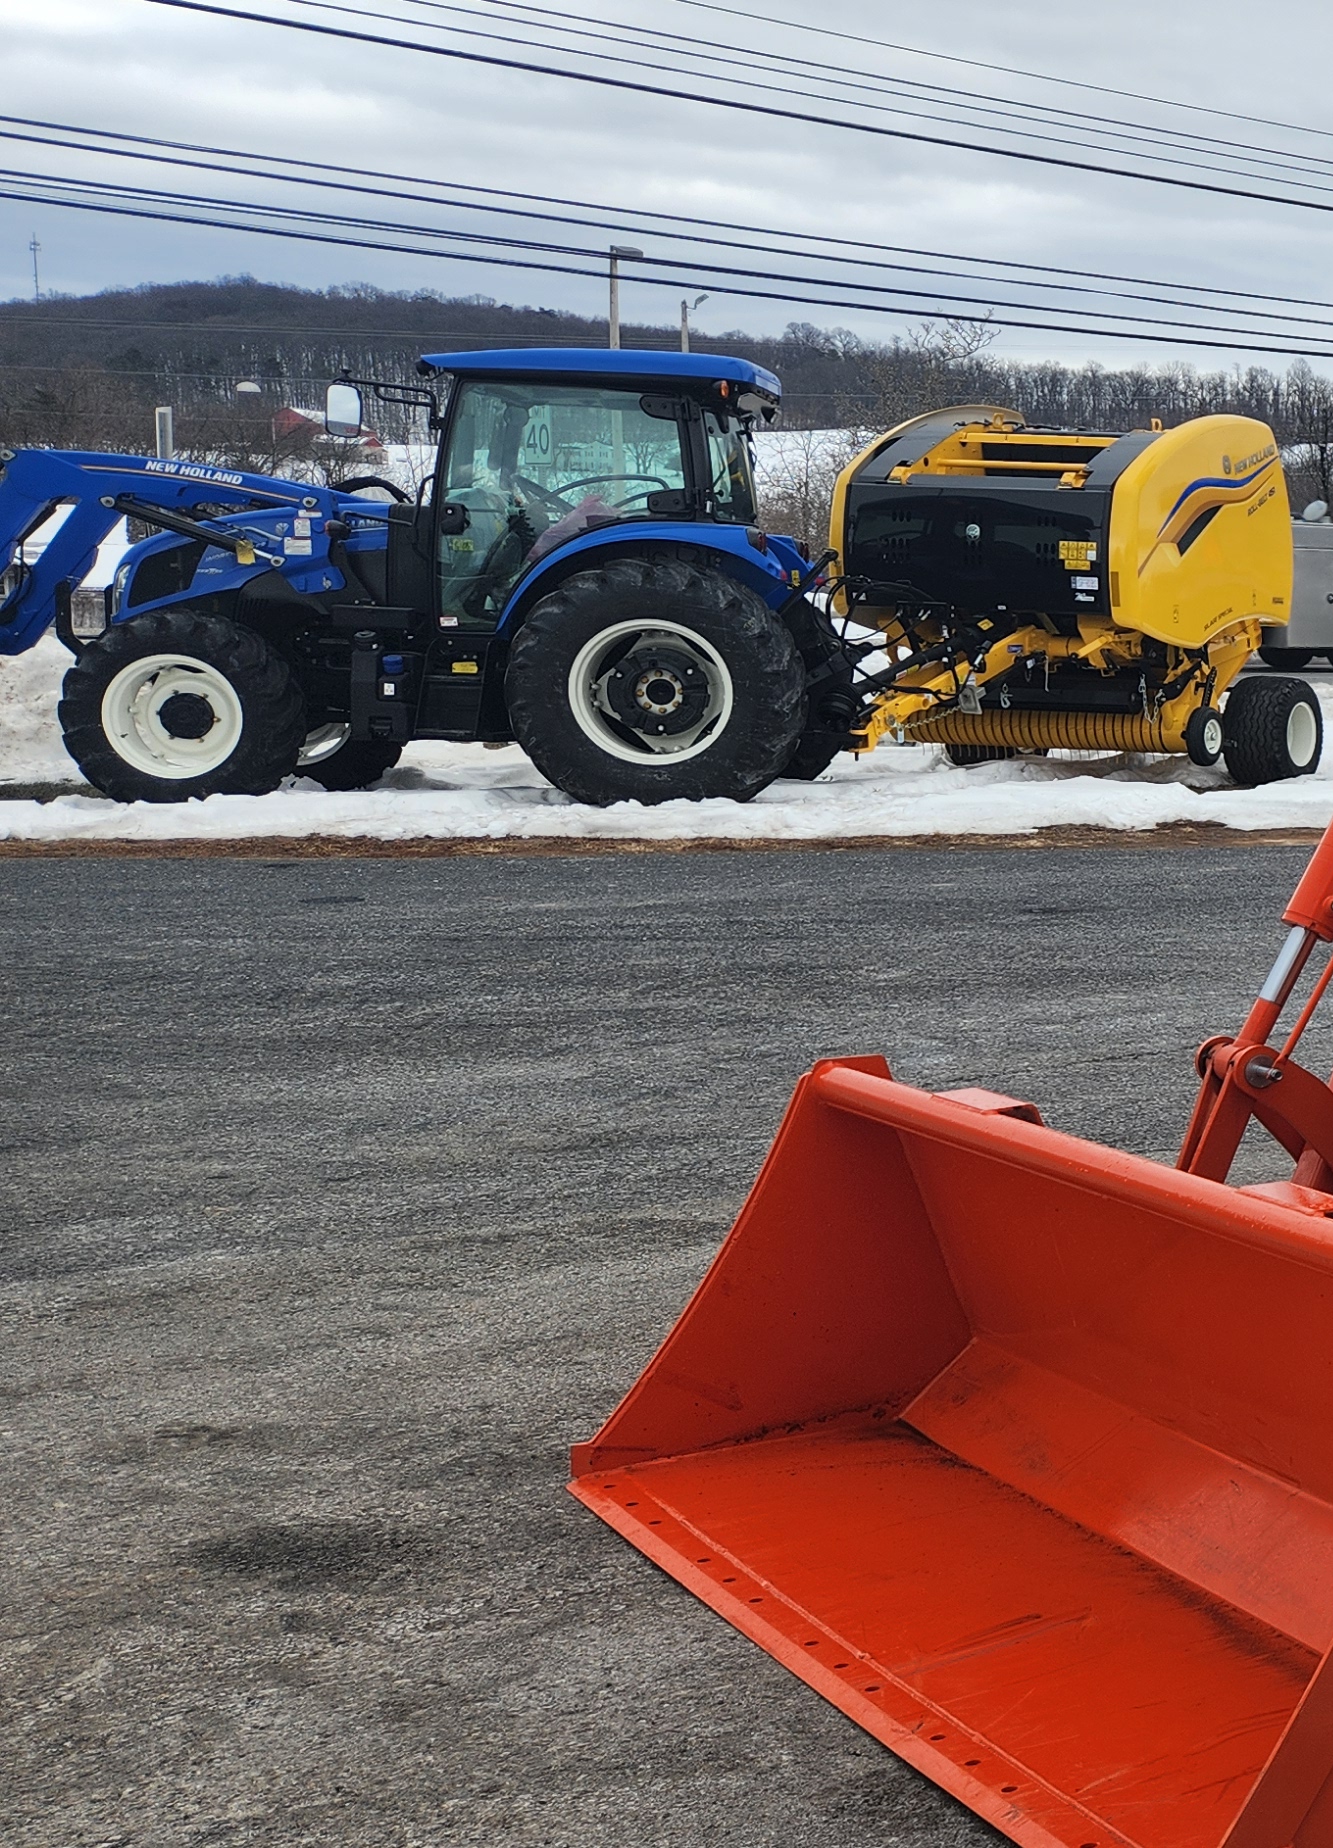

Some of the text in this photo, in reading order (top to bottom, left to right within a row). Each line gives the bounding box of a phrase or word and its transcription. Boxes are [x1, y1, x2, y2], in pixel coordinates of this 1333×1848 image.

[526, 423, 550, 455] 40
[145, 460, 243, 485] NEW HOLLAND
